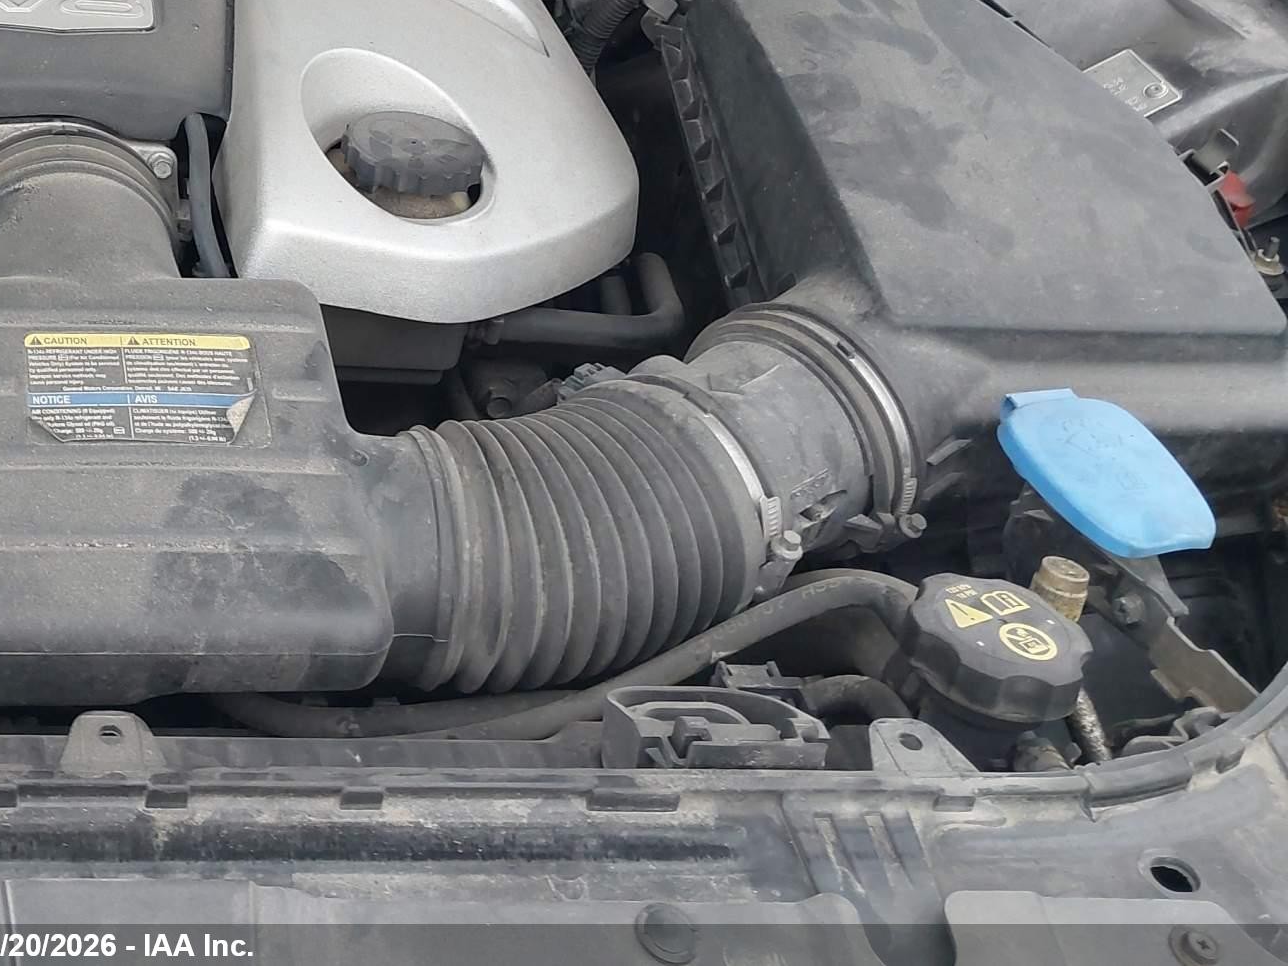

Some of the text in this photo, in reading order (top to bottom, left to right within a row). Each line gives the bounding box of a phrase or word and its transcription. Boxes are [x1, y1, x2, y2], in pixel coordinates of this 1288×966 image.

[44, 337, 88, 345] CAUTION
[141, 338, 196, 347] ATTENTION
[32, 395, 71, 405] NOTICE
[135, 395, 158, 404] AVIS
